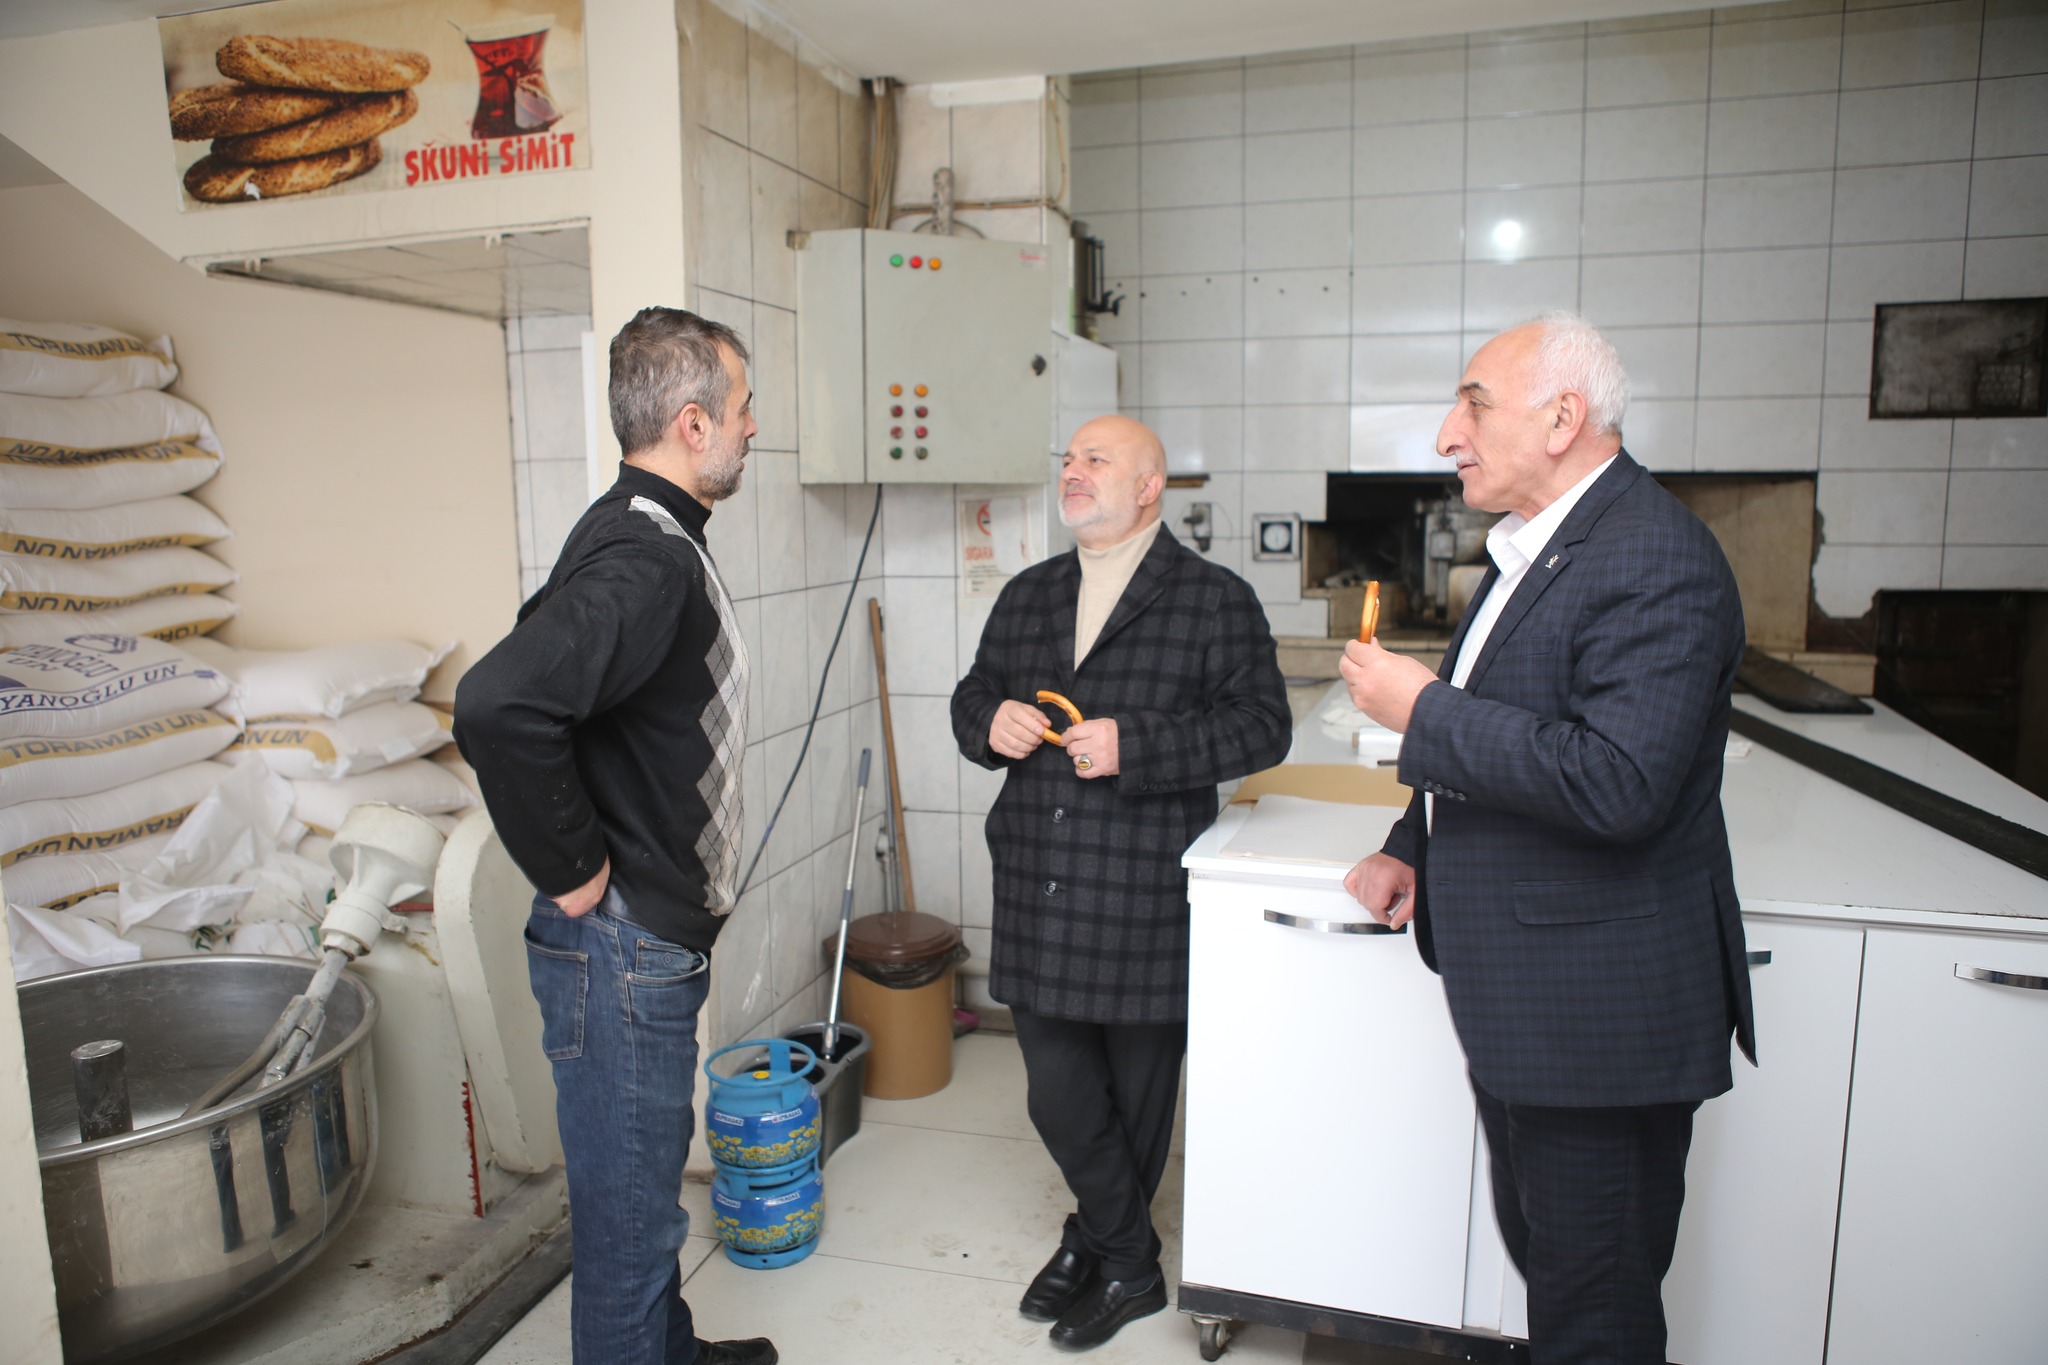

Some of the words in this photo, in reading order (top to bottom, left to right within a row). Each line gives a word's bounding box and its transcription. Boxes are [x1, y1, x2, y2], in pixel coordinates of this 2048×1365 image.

[6, 332, 125, 356] TORAMAN
[13, 539, 57, 557] UN
[17, 596, 59, 611] UN
[144, 664, 177, 683] UN
[8, 721, 165, 759] TORAMAN
[166, 713, 209, 732] UN
[270, 729, 309, 745] UN
